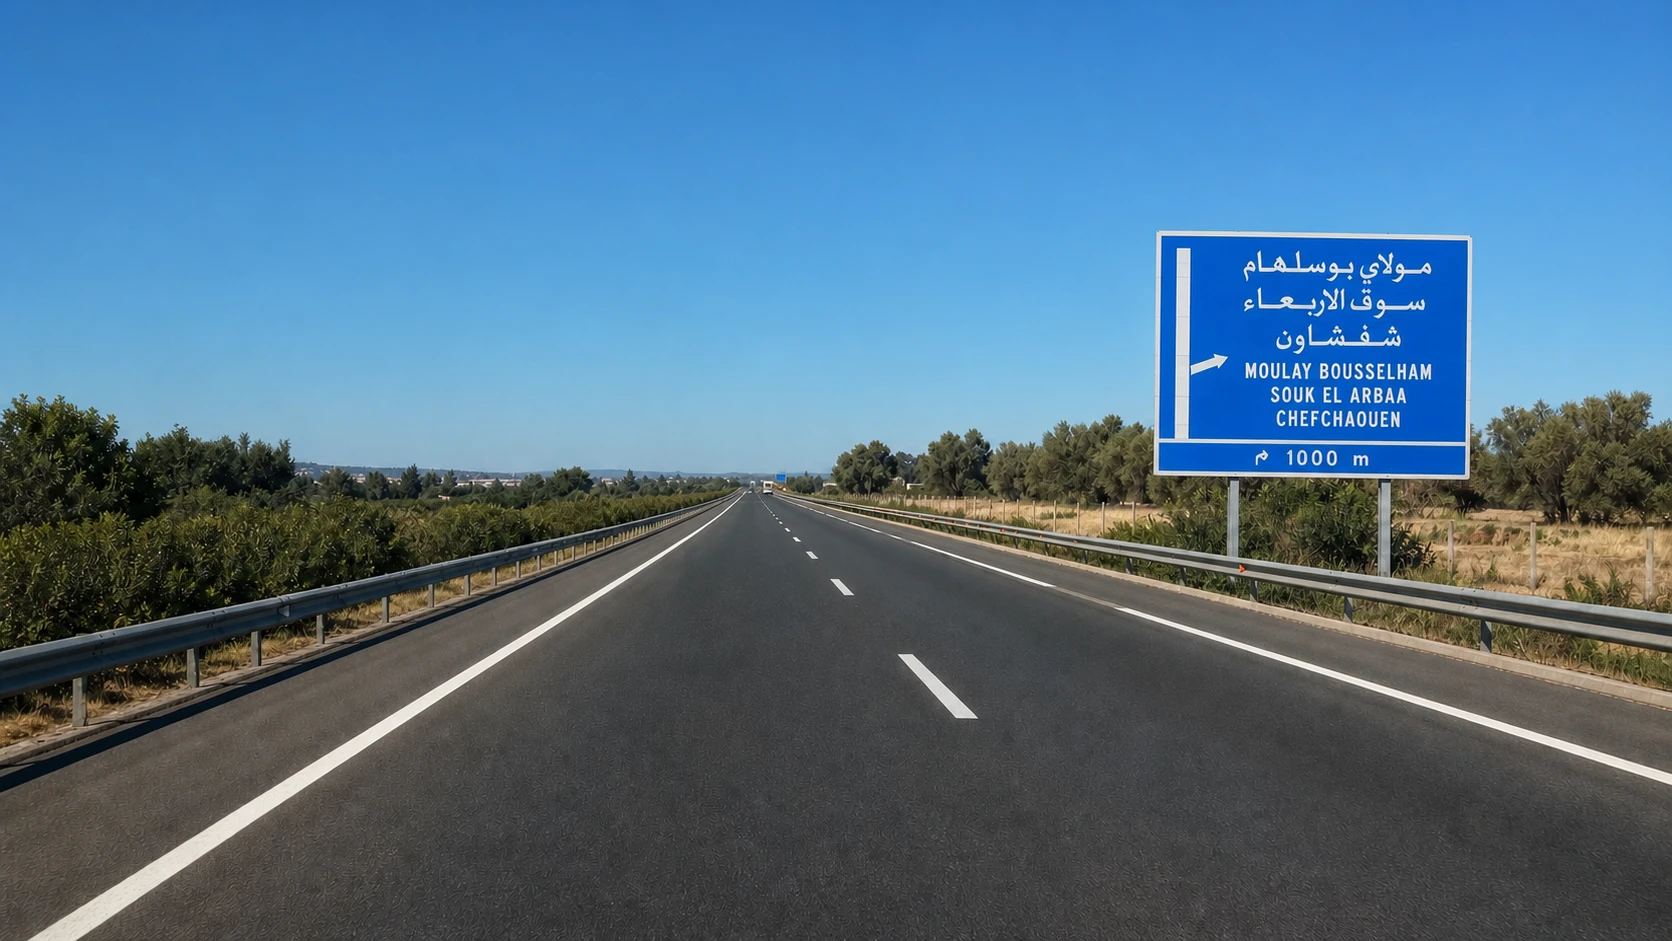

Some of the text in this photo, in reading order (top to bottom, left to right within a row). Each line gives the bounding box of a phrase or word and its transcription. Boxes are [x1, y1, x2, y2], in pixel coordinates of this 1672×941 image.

[1243, 250, 1432, 285] مولاي بوسلهام
[1244, 287, 1426, 319] سوق الاربعاء
[1275, 324, 1402, 355] شفشاون
[1245, 362, 1432, 380] MOULAY BOUSSELHAM
[1270, 386, 1407, 404] SOUK EL ARBAA
[1276, 410, 1401, 428] CHEFCHAOUEN
[1286, 449, 1369, 466] 1000 m
